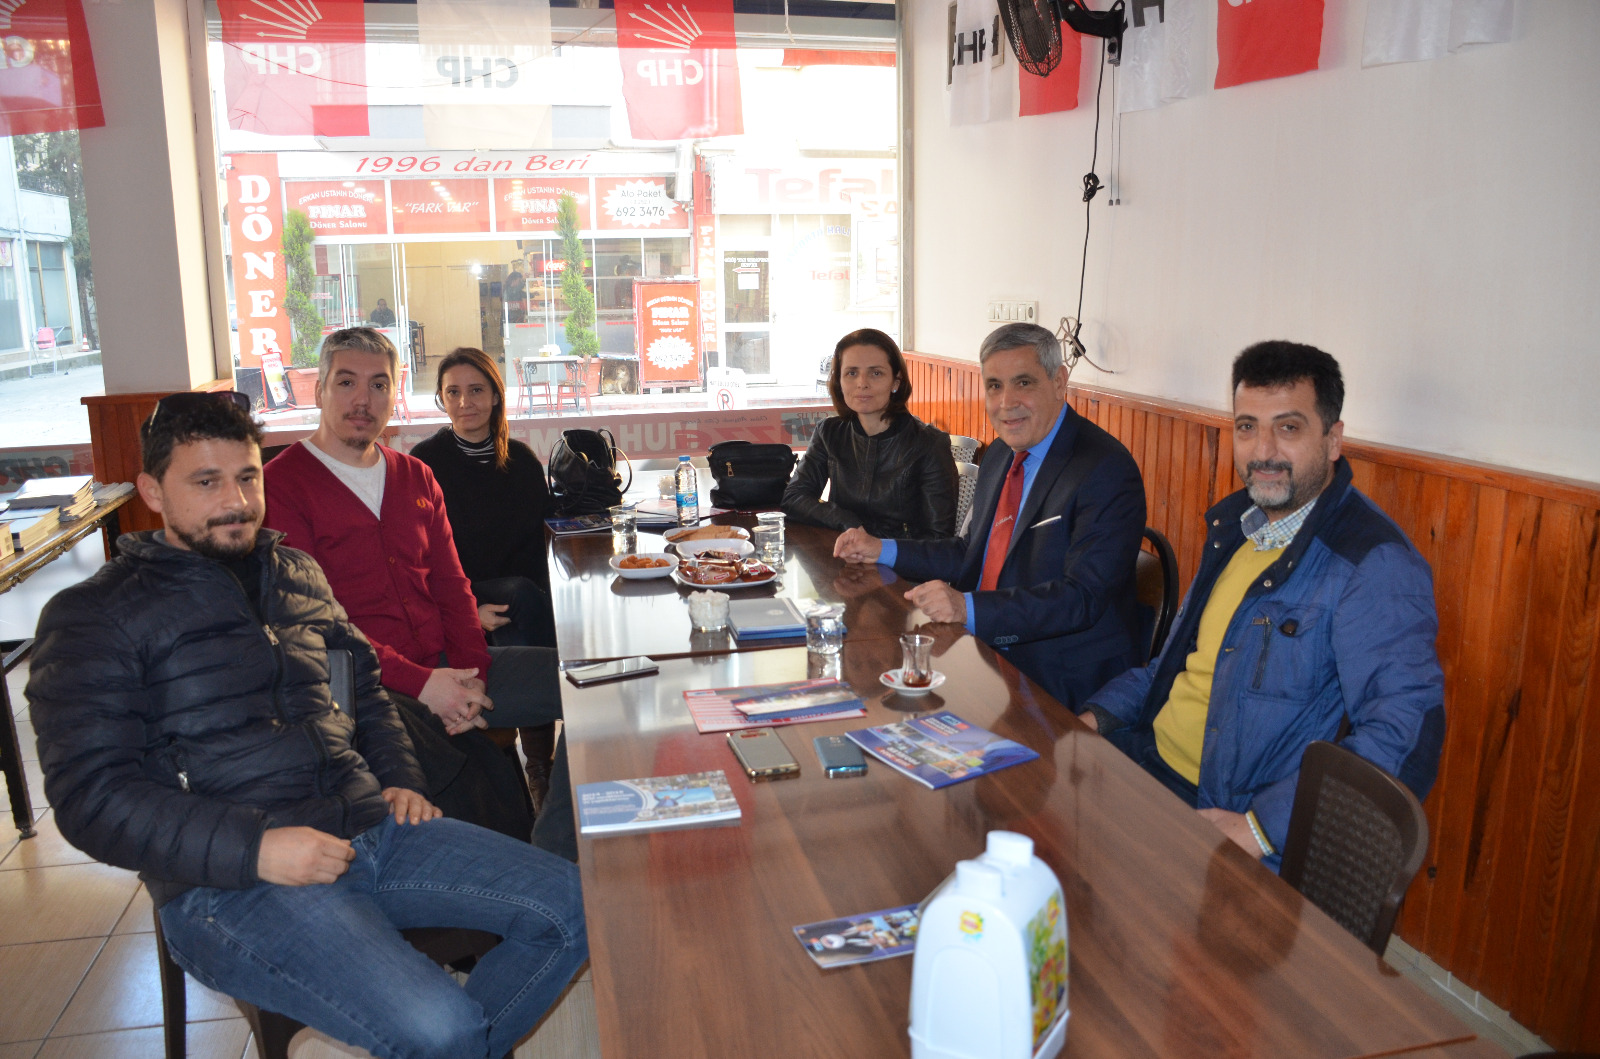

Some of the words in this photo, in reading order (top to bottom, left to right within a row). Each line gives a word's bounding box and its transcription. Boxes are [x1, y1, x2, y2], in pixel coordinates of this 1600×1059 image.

[355, 156, 441, 174] 1996
[453, 156, 513, 172] dan
[525, 154, 592, 172] Beri
[744, 167, 895, 203] Tefal
[308, 204, 368, 219] PINAR
[615, 206, 636, 217] 692
[639, 206, 665, 217] 3476
[238, 175, 282, 356] DÖNER
